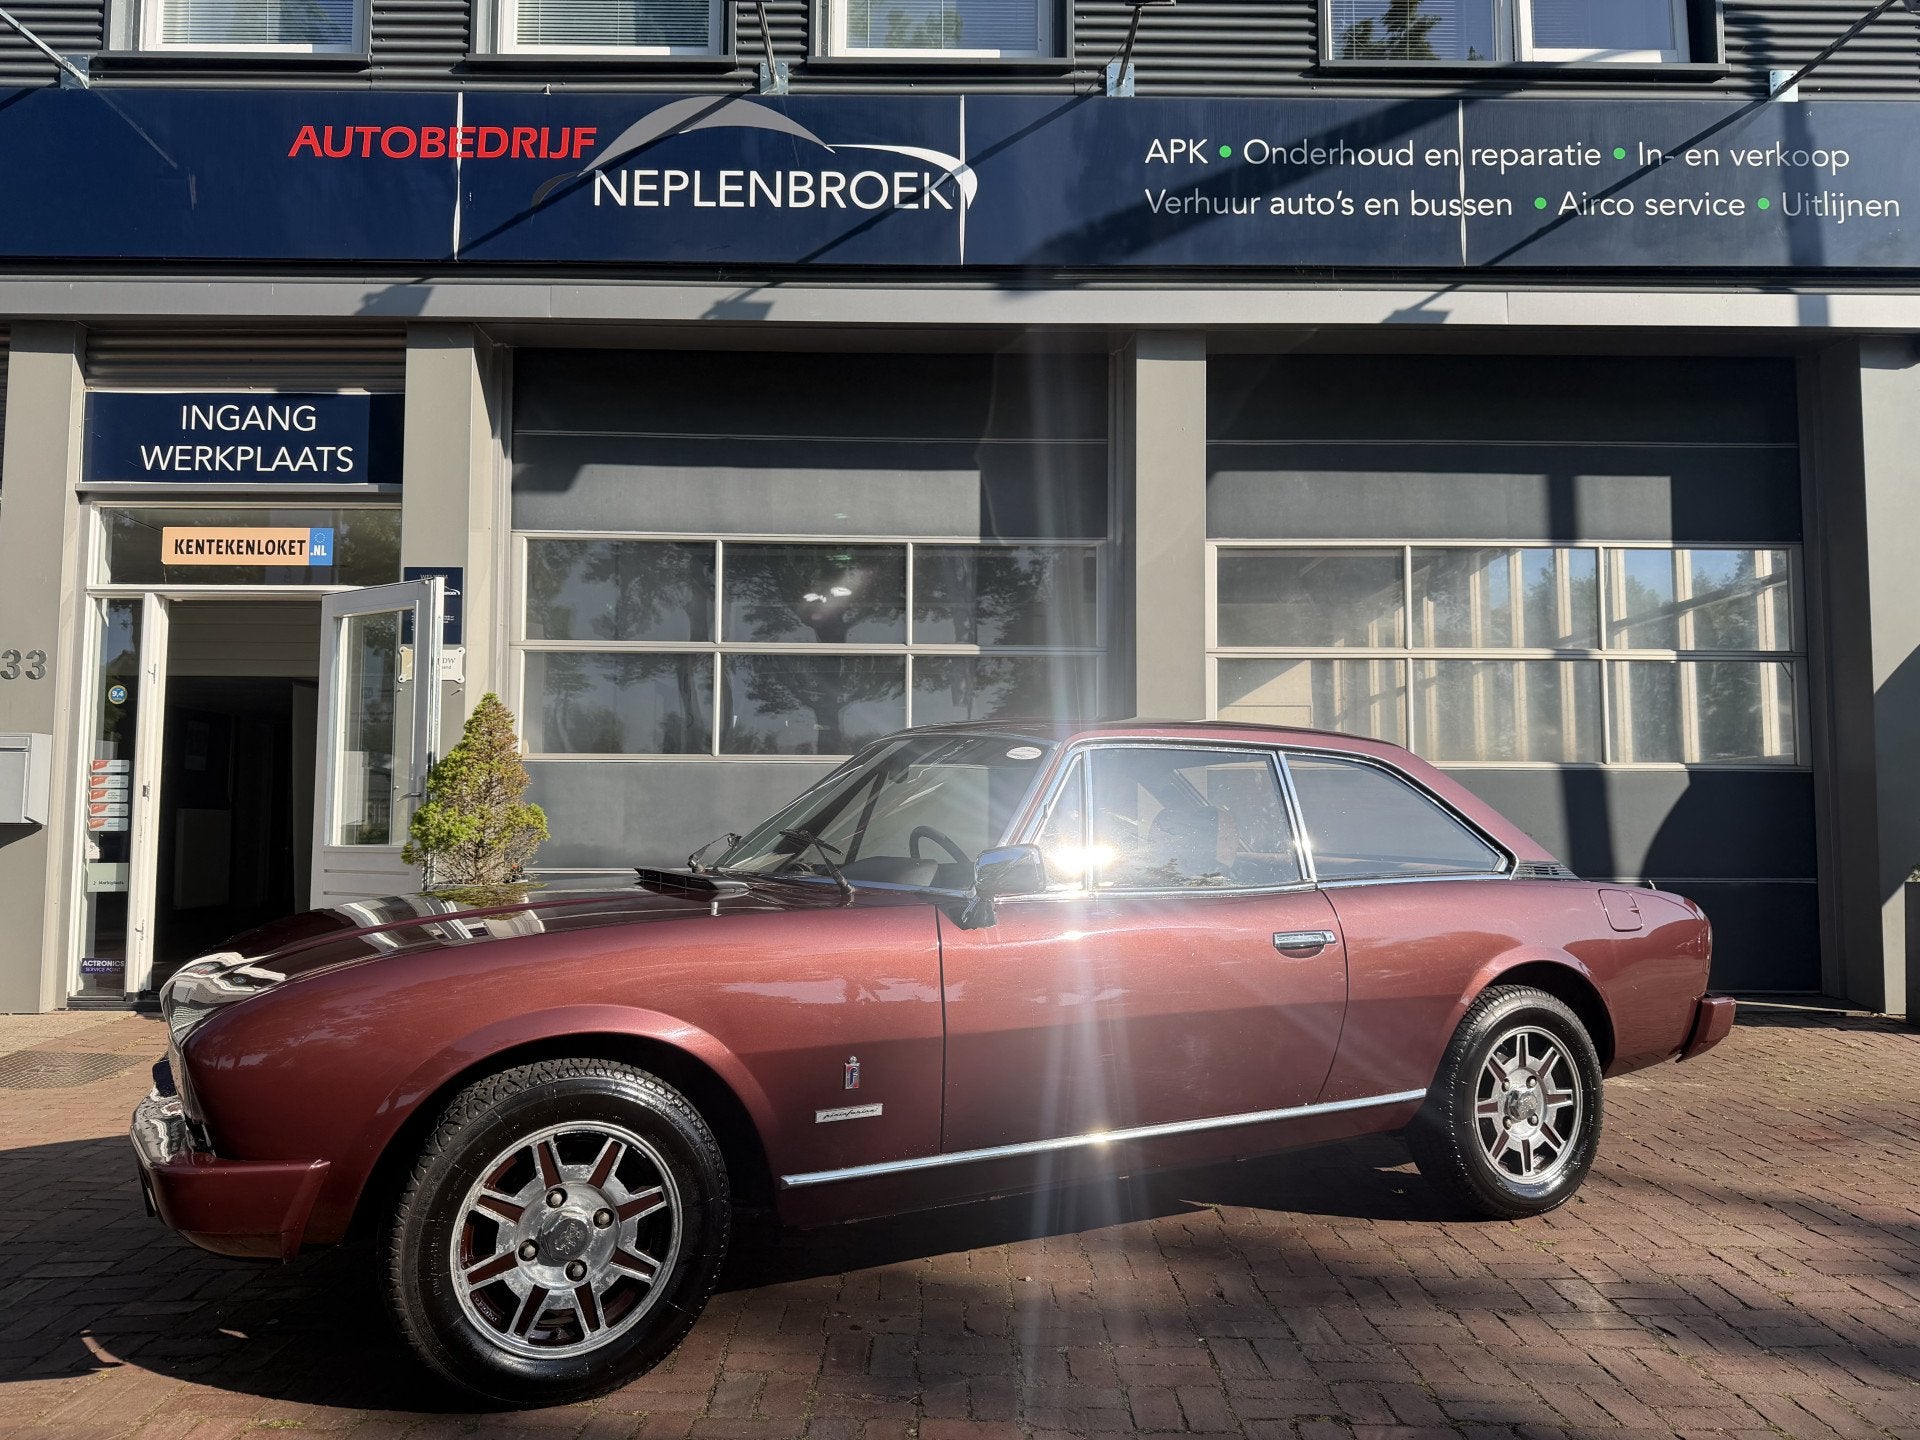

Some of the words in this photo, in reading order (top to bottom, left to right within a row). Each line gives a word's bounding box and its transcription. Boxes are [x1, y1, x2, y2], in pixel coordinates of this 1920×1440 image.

[288, 126, 597, 159] AUTOBEDRIJF
[1145, 138, 1209, 165] APK
[1243, 138, 1415, 167] Onderhoud
[1424, 148, 1461, 167] en
[1471, 142, 1602, 176] reparatie
[1638, 143, 1675, 167] In-
[1685, 149, 1719, 167] en
[1730, 142, 1850, 176] verkoop
[594, 169, 954, 210] NEPLENBROEK
[1145, 188, 1260, 215] Verhuur
[1364, 198, 1399, 216] en
[1410, 190, 1513, 217] bussen
[1558, 191, 1635, 217] Airco
[1645, 191, 1746, 217] service
[1782, 192, 1901, 225] Uitlijnen
[181, 405, 317, 432] INGANG
[140, 445, 354, 473] WERKPLAATS
[174, 538, 307, 556] KENTEKENLOKET
[0, 649, 47, 680] 33
